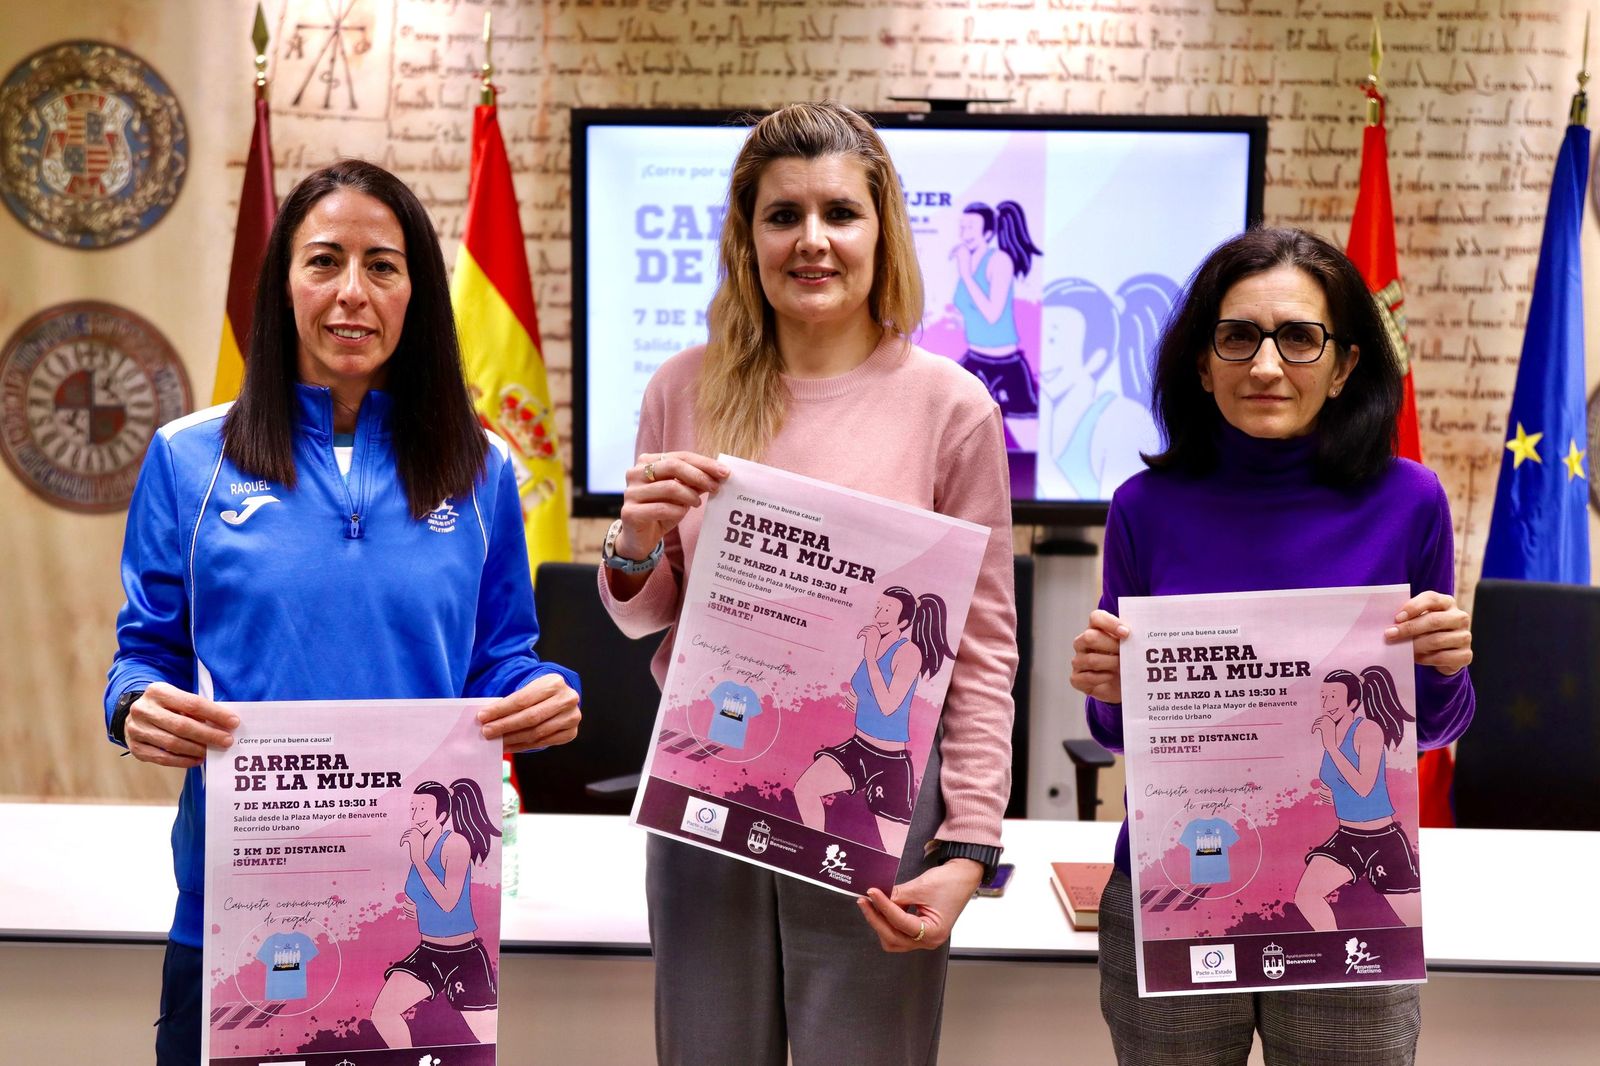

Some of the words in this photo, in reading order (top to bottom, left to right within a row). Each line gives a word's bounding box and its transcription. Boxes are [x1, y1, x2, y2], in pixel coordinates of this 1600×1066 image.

[635, 248, 703, 284] DE
[633, 308, 646, 326] 7
[655, 308, 686, 326] DE
[230, 480, 270, 494] RAQUEL
[737, 494, 755, 504] ¡Corre
[756, 499, 767, 507] por
[781, 506, 800, 516] buena
[801, 512, 821, 522] causa!
[729, 510, 830, 552] CARRERA
[724, 527, 754, 548] DE
[760, 538, 788, 559] LA
[796, 548, 876, 584] MUJER
[728, 553, 741, 563] DE
[744, 558, 777, 574] MARZO
[779, 569, 786, 577] A
[790, 572, 808, 584] LAS
[812, 578, 837, 591] 19:30
[840, 586, 848, 594] H
[715, 572, 746, 585] Recorrido
[748, 581, 772, 594] Urbano
[717, 562, 736, 573] Salida
[737, 568, 757, 579] desde
[758, 573, 764, 581] la
[766, 576, 783, 588] Plaza
[785, 583, 806, 594] Mayor
[807, 589, 816, 597] de
[817, 592, 853, 608] Benavente
[708, 600, 753, 621] ¡SÚMATE!
[719, 594, 734, 605] KM
[737, 600, 750, 610] DE
[753, 604, 808, 627] DISTANCIA
[692, 634, 731, 655] Camiseta
[1146, 645, 1257, 663] CARRERA
[722, 660, 732, 672] de
[736, 671, 765, 683] regalo
[1147, 666, 1177, 682] DE
[1186, 665, 1217, 681] LA
[1226, 661, 1311, 679] MUJER
[1157, 692, 1170, 700] DE
[1175, 691, 1210, 699] MARZO
[1225, 690, 1245, 698] LAS
[1249, 688, 1275, 697] 19:30
[1279, 688, 1287, 696] H
[1150, 736, 1156, 744] 3
[1181, 735, 1195, 743] DE
[1198, 733, 1258, 742] DISTANCIA
[1150, 744, 1201, 754] ¡SÚMATE!
[235, 754, 349, 771] CARRERA
[235, 775, 266, 791] DE
[276, 774, 307, 790] LA
[317, 772, 401, 789] MUJER
[1145, 784, 1189, 797] Camiseta
[234, 802, 240, 810] 7
[244, 802, 258, 810] DE
[262, 801, 299, 809] MARZO
[304, 801, 311, 809] A
[315, 800, 335, 808] LAS
[339, 799, 366, 807] 19:30
[370, 799, 378, 807] H
[1184, 798, 1195, 813] de
[1201, 797, 1232, 815] regalo
[258, 814, 280, 822] desde
[312, 813, 335, 822] Mayor
[233, 848, 240, 856] 3
[266, 847, 280, 855] DE
[284, 845, 346, 854] DISTANCIA
[770, 840, 796, 853] Benavente
[233, 857, 286, 867] ¡SÚMATE!
[224, 897, 270, 911] Camiseta
[264, 912, 276, 926] de
[282, 911, 314, 930] regalo
